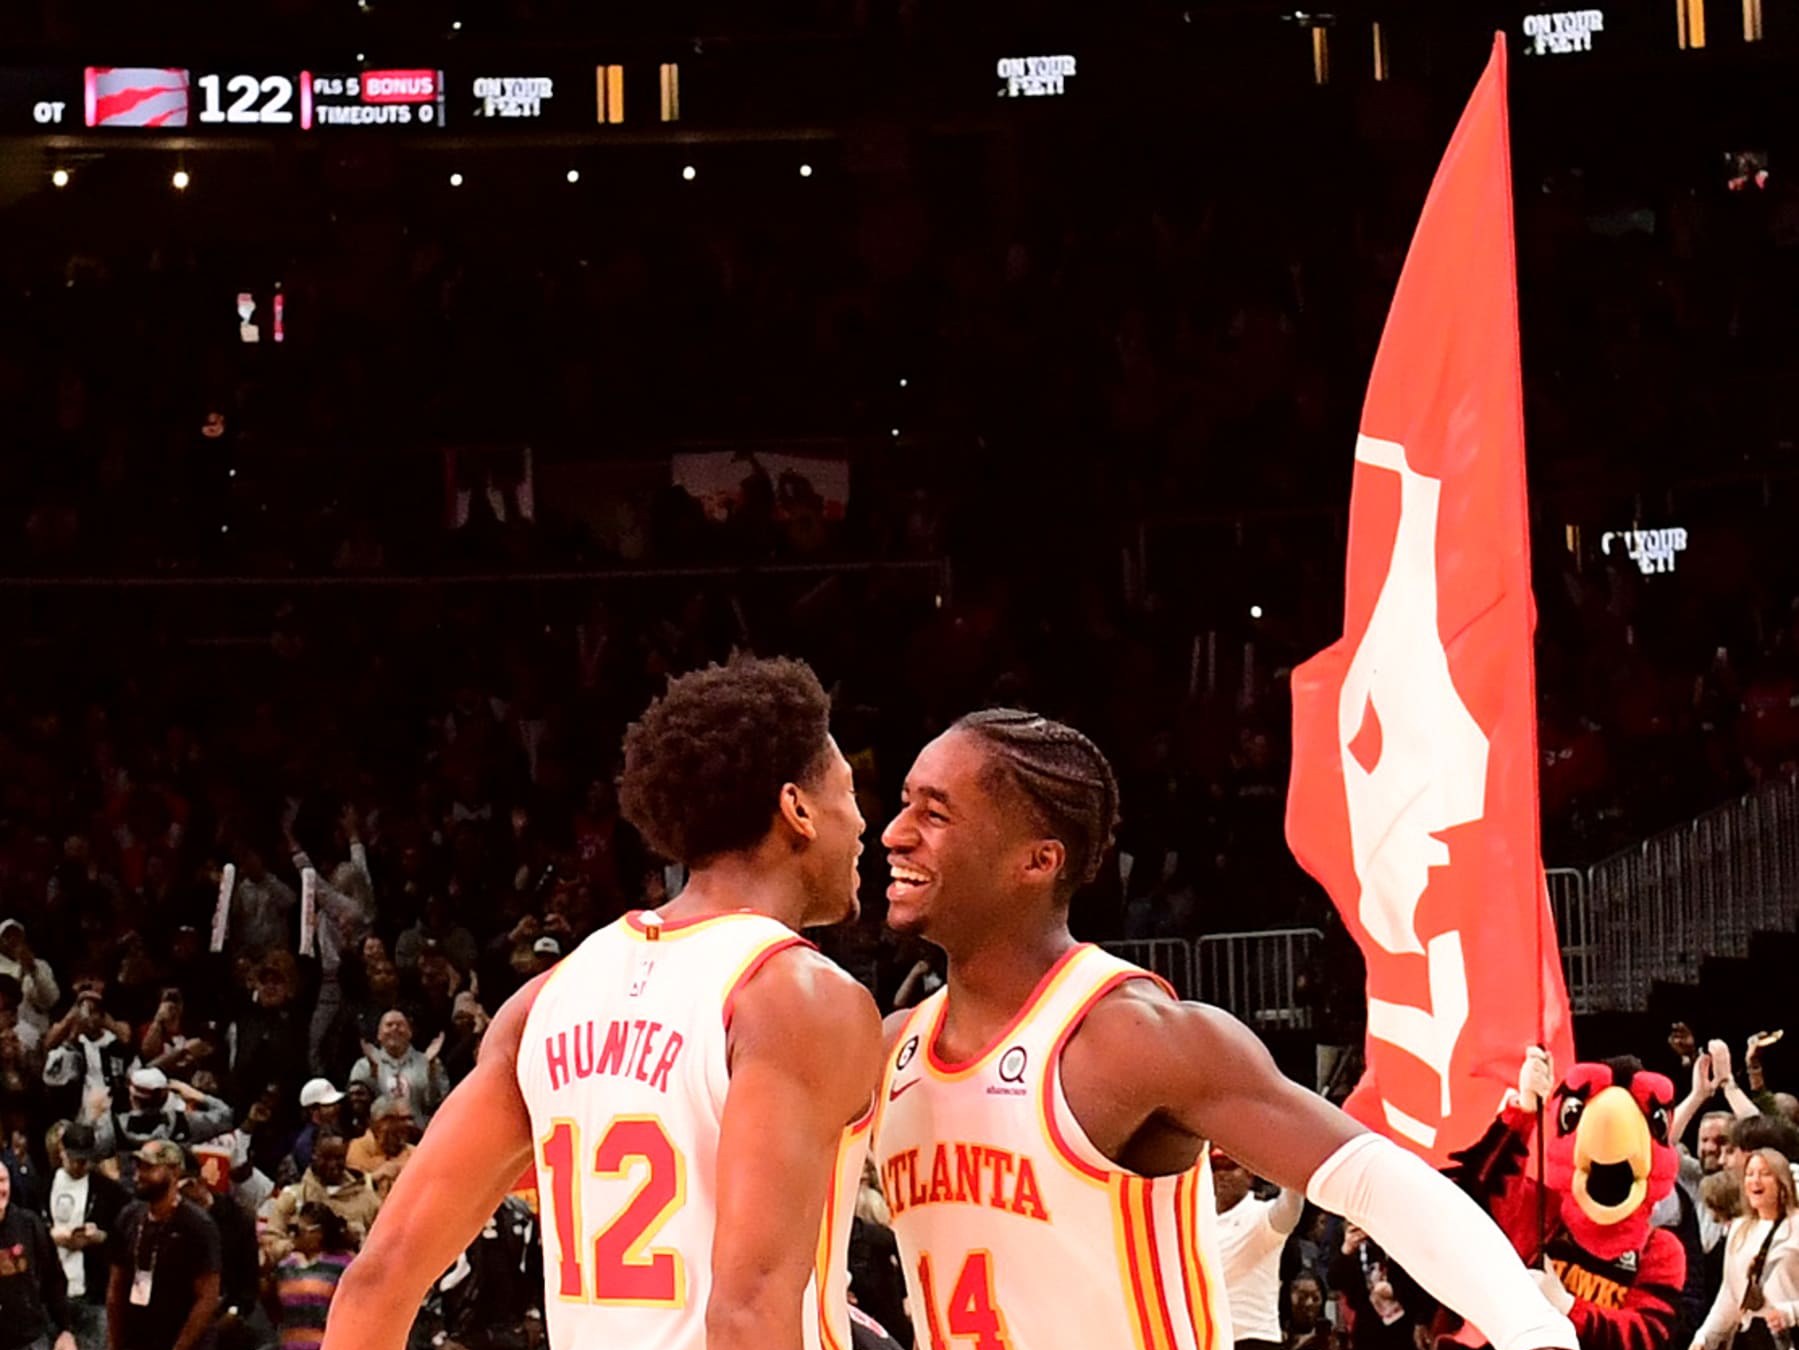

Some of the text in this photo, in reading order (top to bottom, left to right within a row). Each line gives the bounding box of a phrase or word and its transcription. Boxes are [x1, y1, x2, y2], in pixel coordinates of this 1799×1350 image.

[1523, 14, 1550, 36] ON
[997, 57, 1024, 79] ON
[313, 77, 434, 97] FLS 5 BONUS
[473, 77, 500, 98] ON
[198, 75, 293, 123] 122
[33, 101, 66, 124] OT
[316, 104, 434, 124] TIMEOUTS 0
[545, 1019, 684, 1093] HUNTER
[540, 1113, 686, 1309] 12
